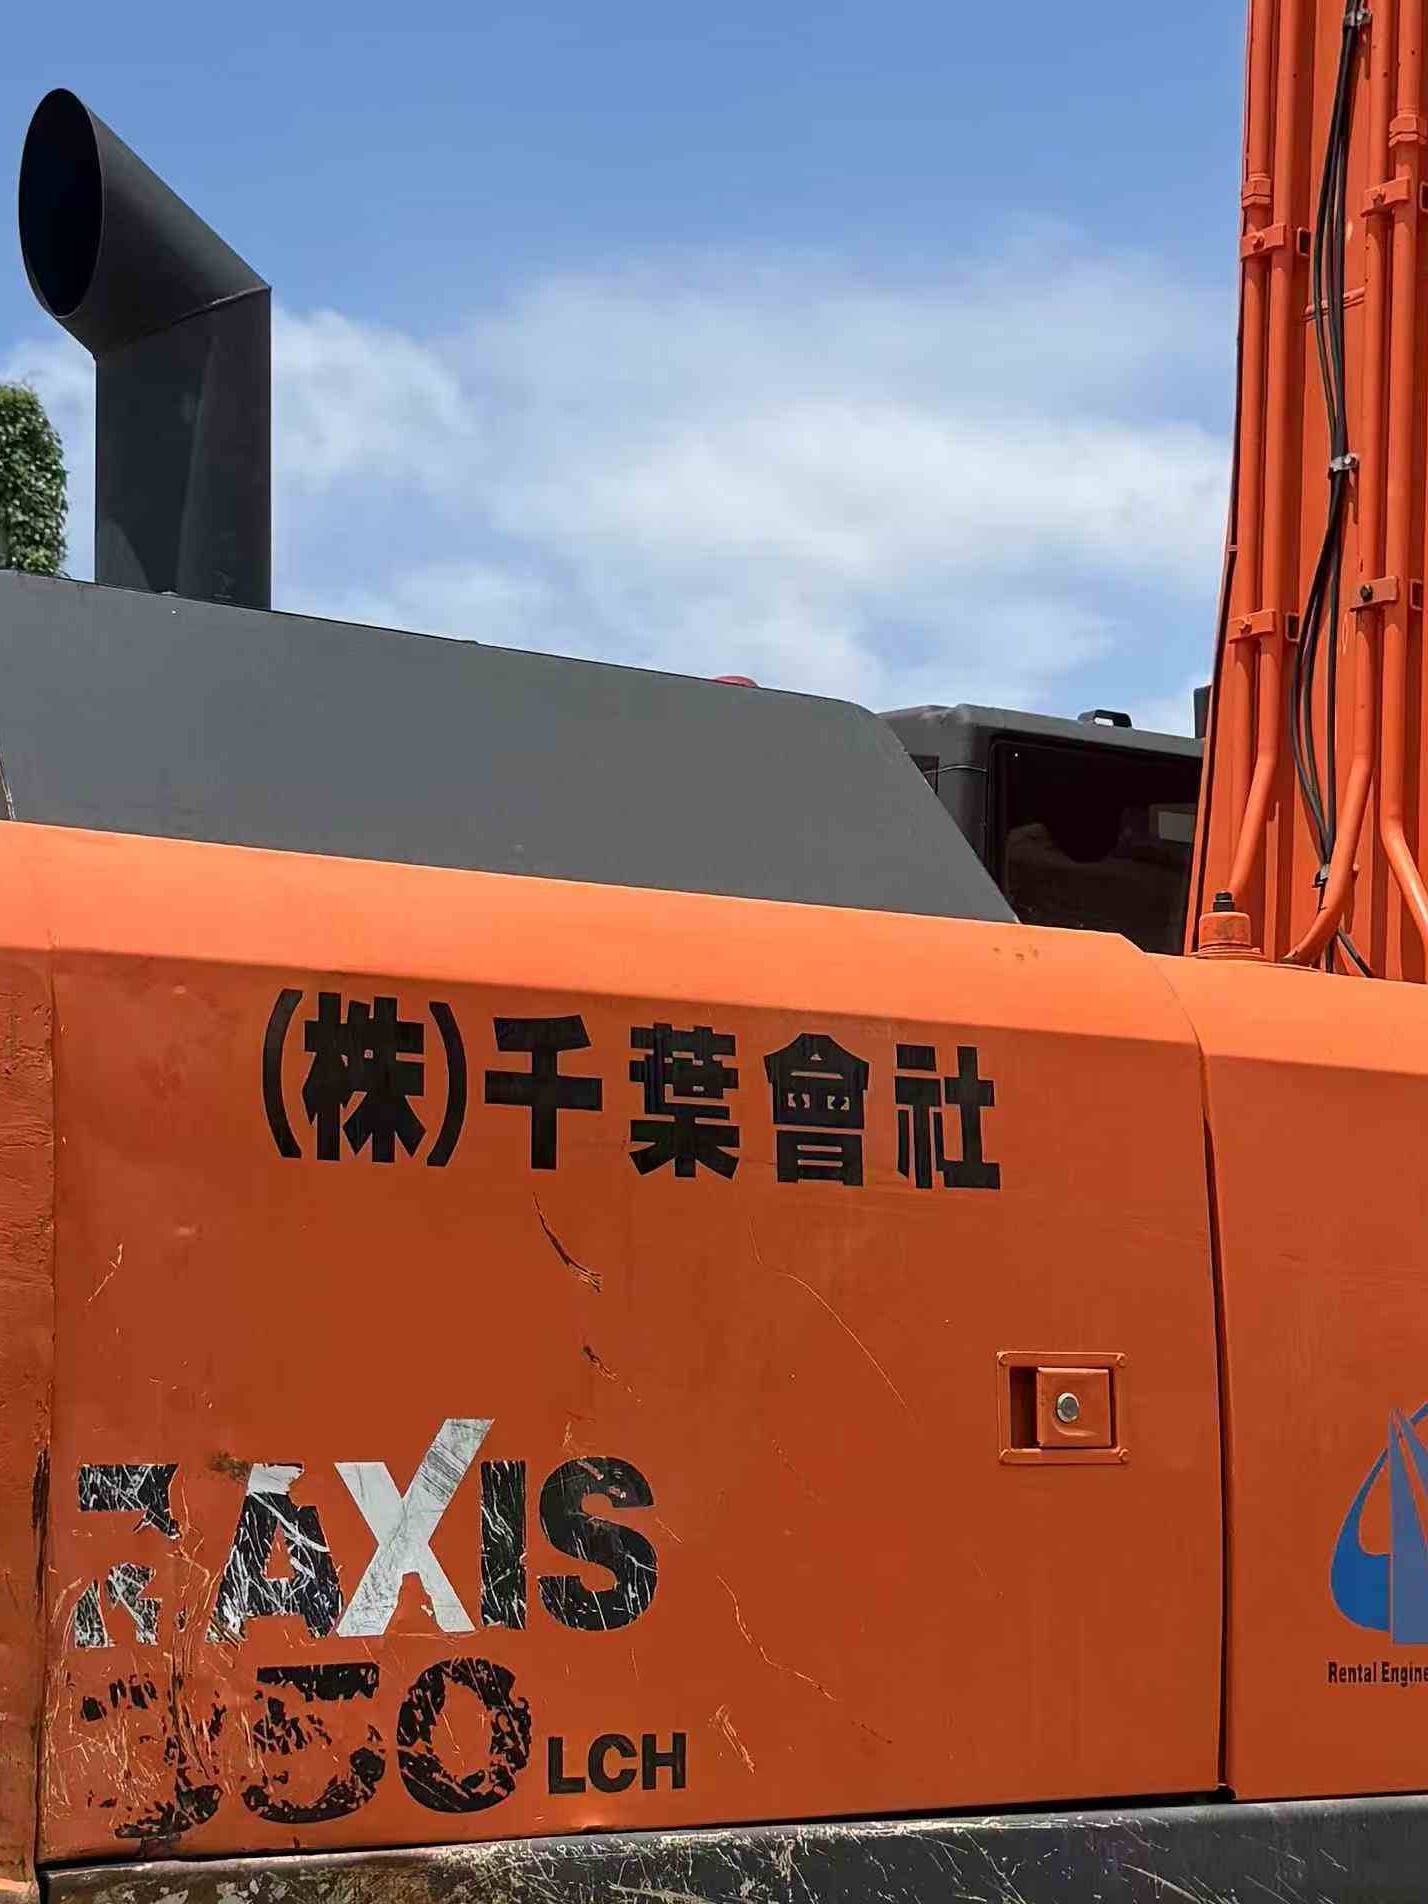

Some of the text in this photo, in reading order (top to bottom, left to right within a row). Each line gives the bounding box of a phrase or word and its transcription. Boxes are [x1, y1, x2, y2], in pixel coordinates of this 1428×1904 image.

[264, 988, 1002, 1189] (株)千葉會社
[1328, 1660, 1377, 1683] Rental
